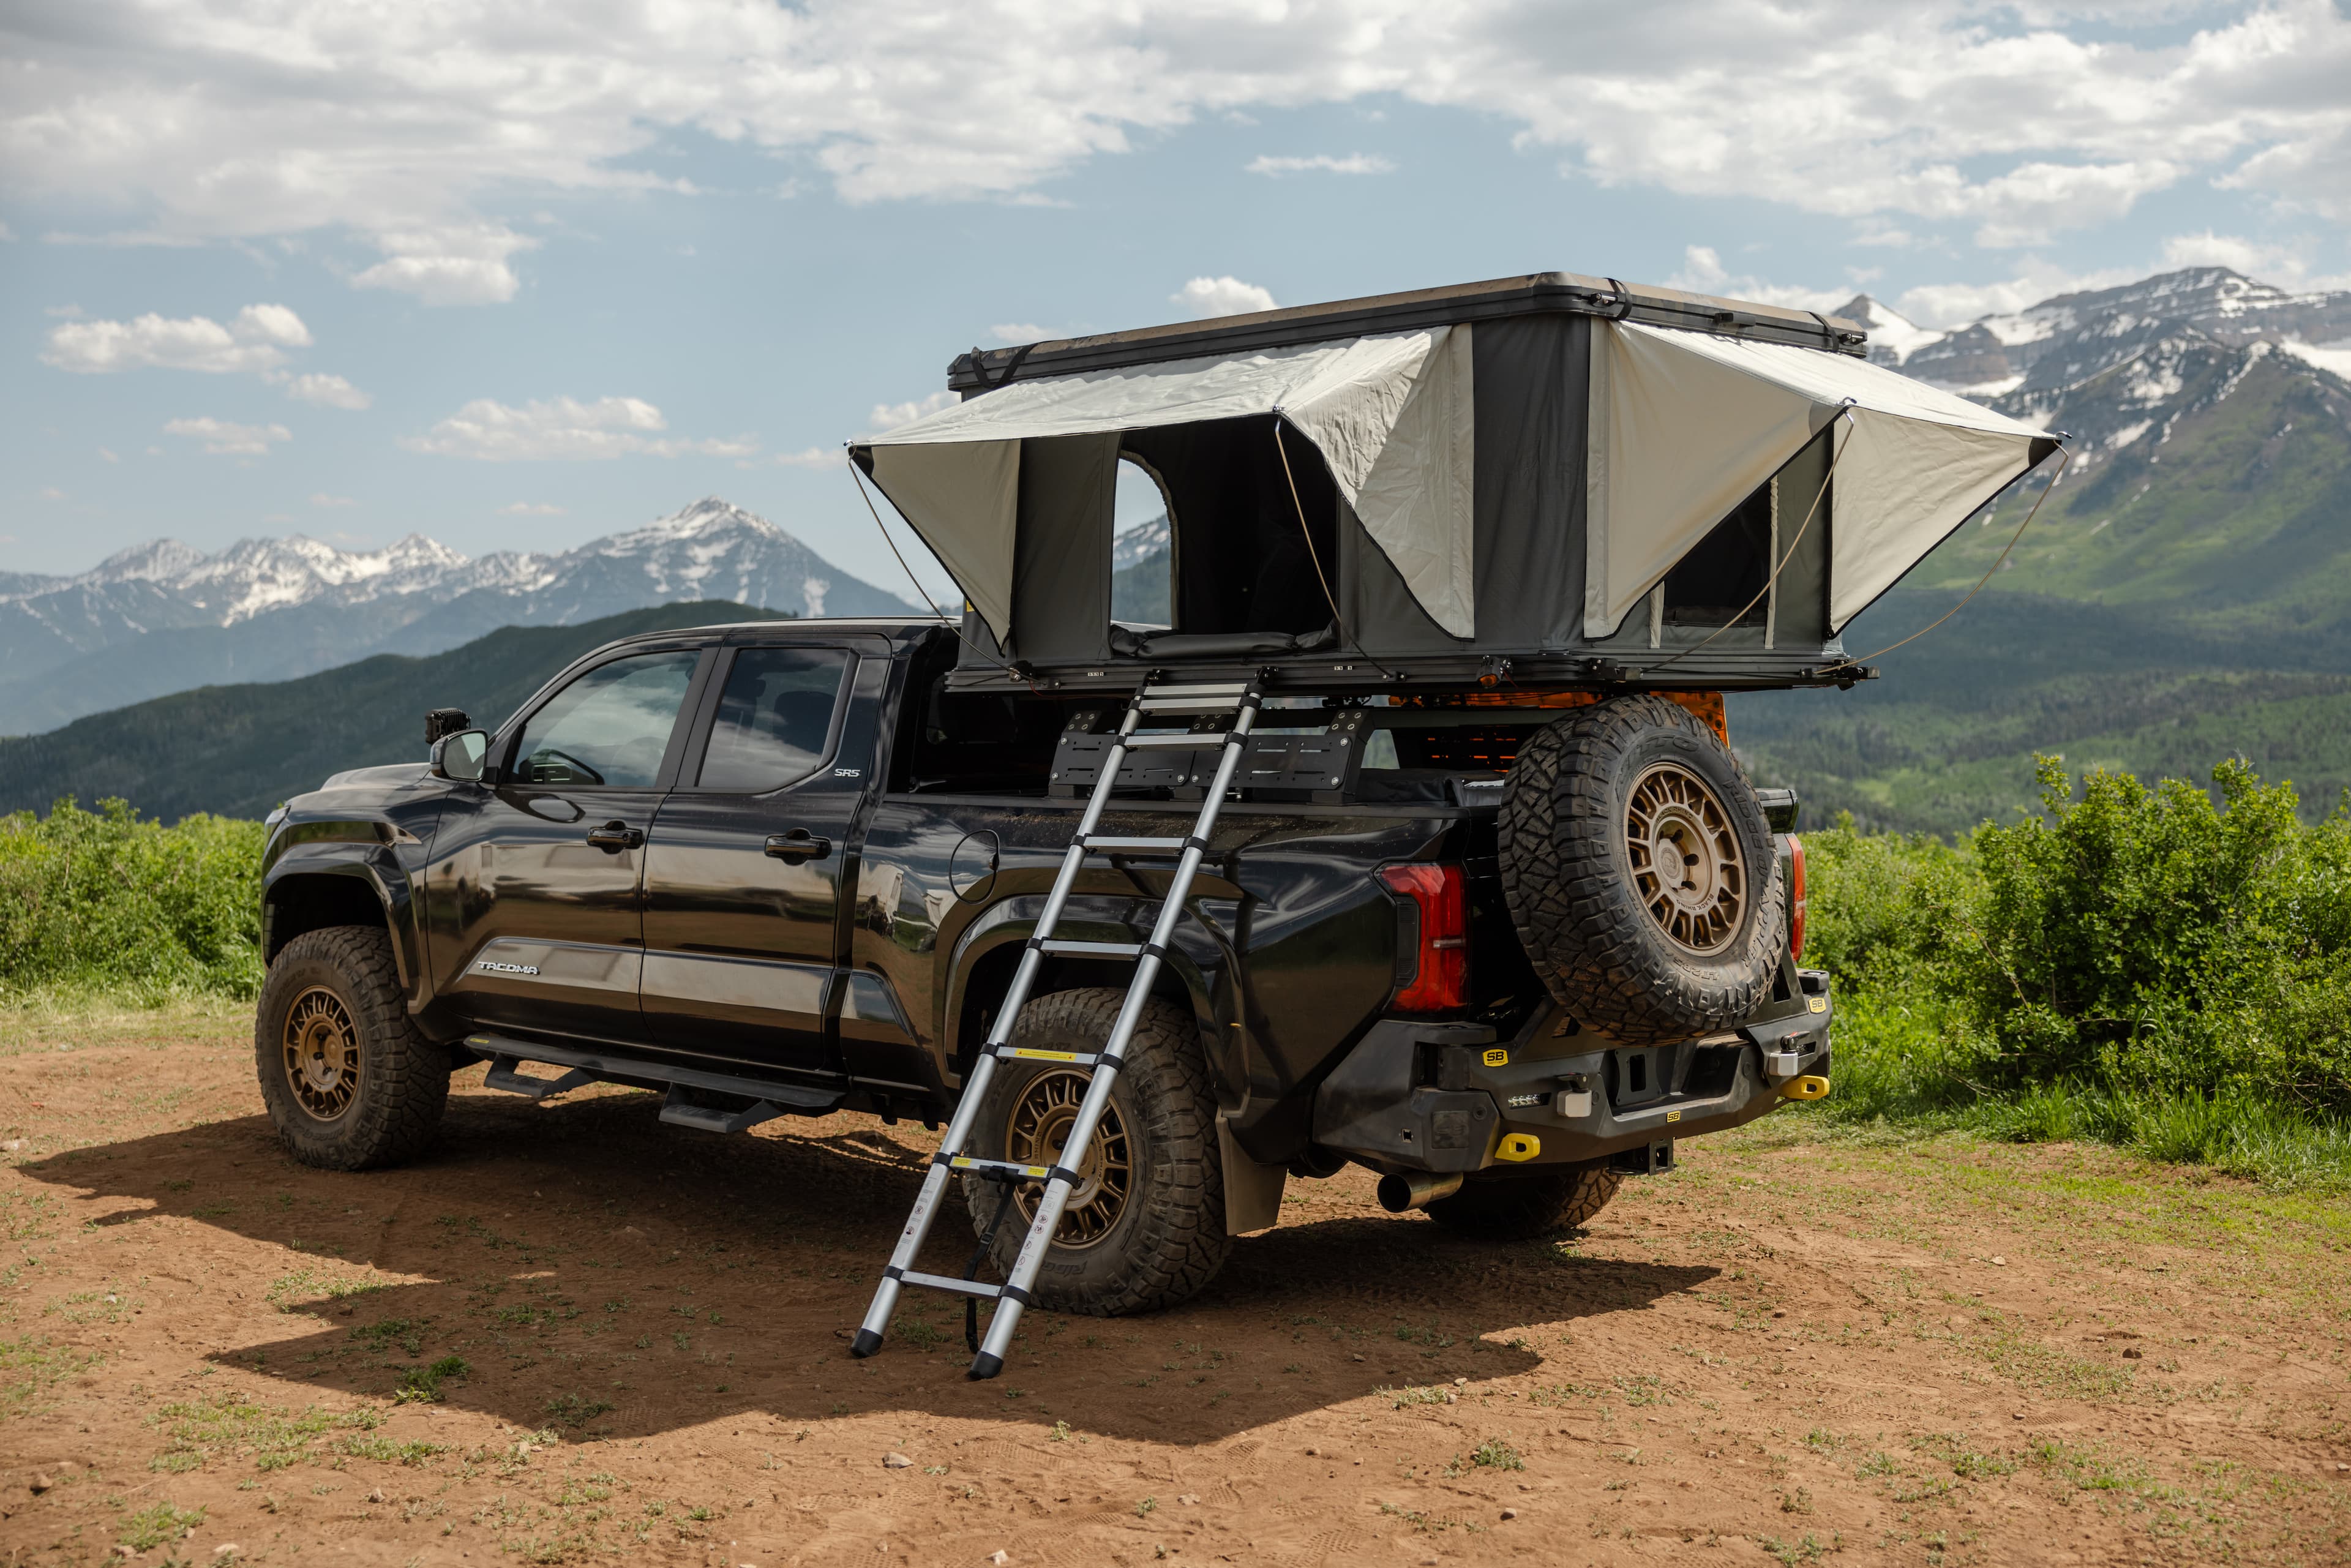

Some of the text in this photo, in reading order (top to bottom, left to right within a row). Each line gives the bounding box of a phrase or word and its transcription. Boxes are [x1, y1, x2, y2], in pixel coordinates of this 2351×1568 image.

[834, 768, 861, 777] SR5
[1655, 806, 1693, 824] BLACK RHINO
[1676, 893, 1714, 912] BLACK RHINO
[478, 961, 539, 975] TACOMA
[1812, 999, 1823, 1008] SB
[1487, 1052, 1504, 1061] SB
